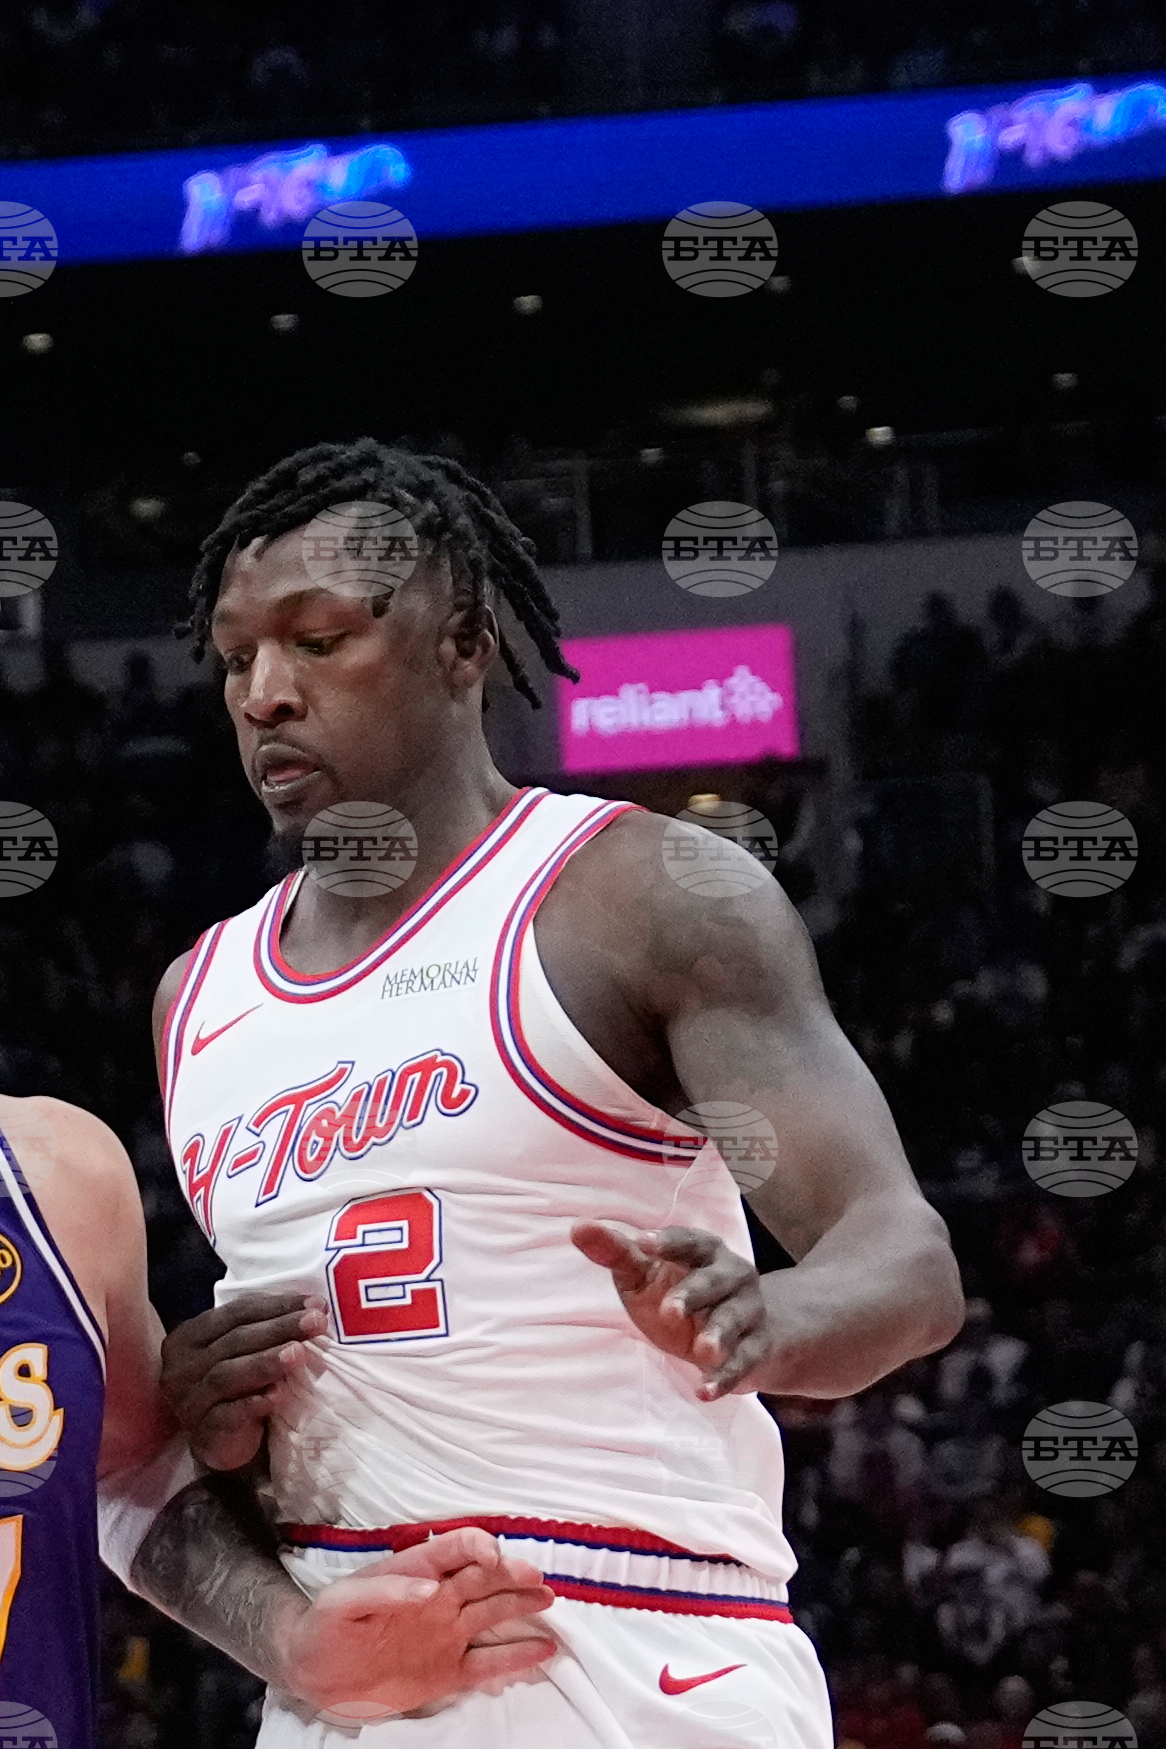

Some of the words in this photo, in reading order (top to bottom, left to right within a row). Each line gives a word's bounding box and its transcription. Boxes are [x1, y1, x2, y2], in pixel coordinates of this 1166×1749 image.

[571, 679, 724, 736] reliant
[380, 969, 479, 1000] HERMANN
[383, 957, 480, 986] MEMORIAL
[181, 1049, 479, 1250] H-Town
[324, 1186, 450, 1345] 2
